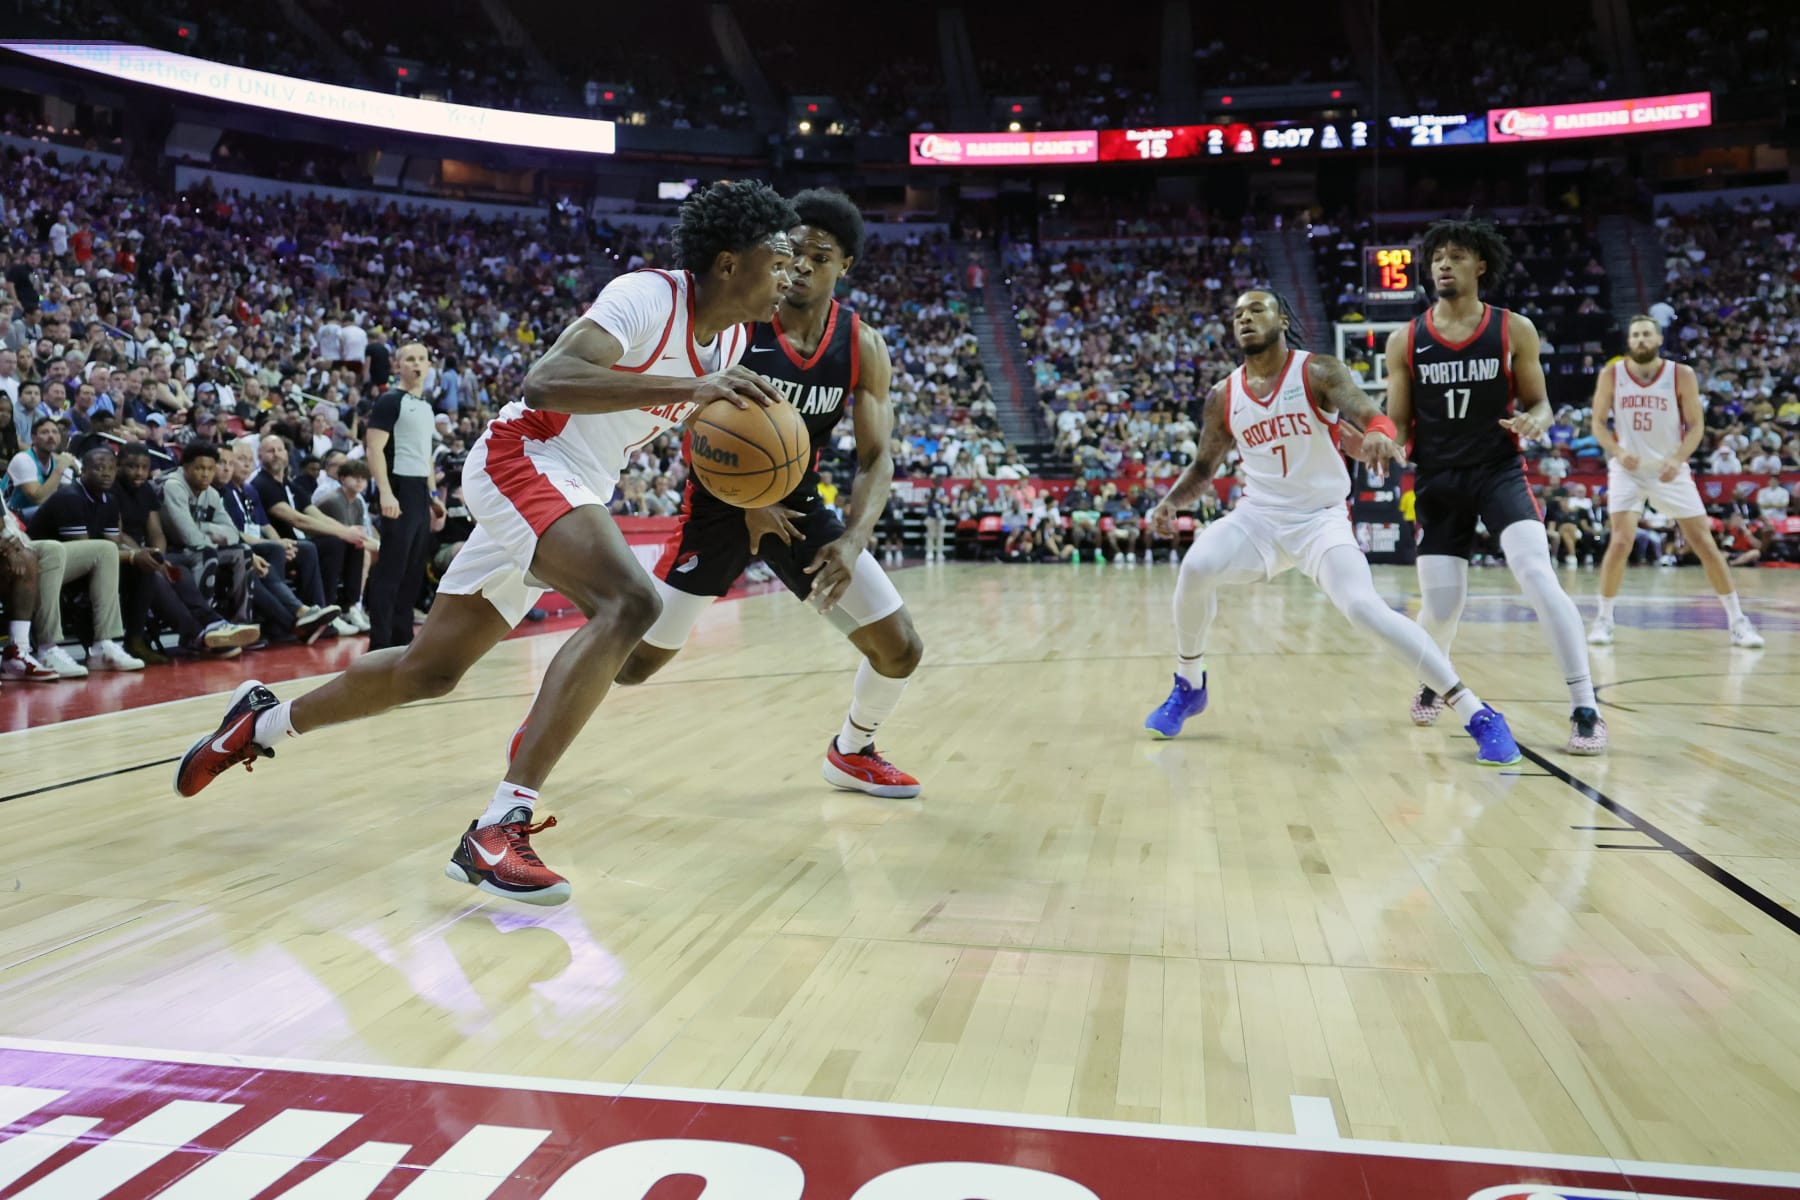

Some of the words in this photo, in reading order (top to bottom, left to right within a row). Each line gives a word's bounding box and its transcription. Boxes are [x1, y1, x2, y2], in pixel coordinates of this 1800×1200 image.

[118, 54, 200, 84] partner
[208, 73, 230, 90] of
[238, 78, 296, 102] UNLV
[1208, 129, 1224, 146] 2
[1262, 128, 1314, 149] 5:07
[1352, 121, 1368, 138] 2
[1411, 125, 1443, 146] 21
[1136, 139, 1168, 159] 15
[1381, 265, 1408, 289] 15
[1418, 358, 1500, 385] PORTLAND
[1444, 388, 1471, 419] 17
[1622, 394, 1668, 411] ROCKETS
[1241, 413, 1312, 448] ROCKETS
[1633, 411, 1652, 432] 65
[1272, 445, 1288, 478] 7
